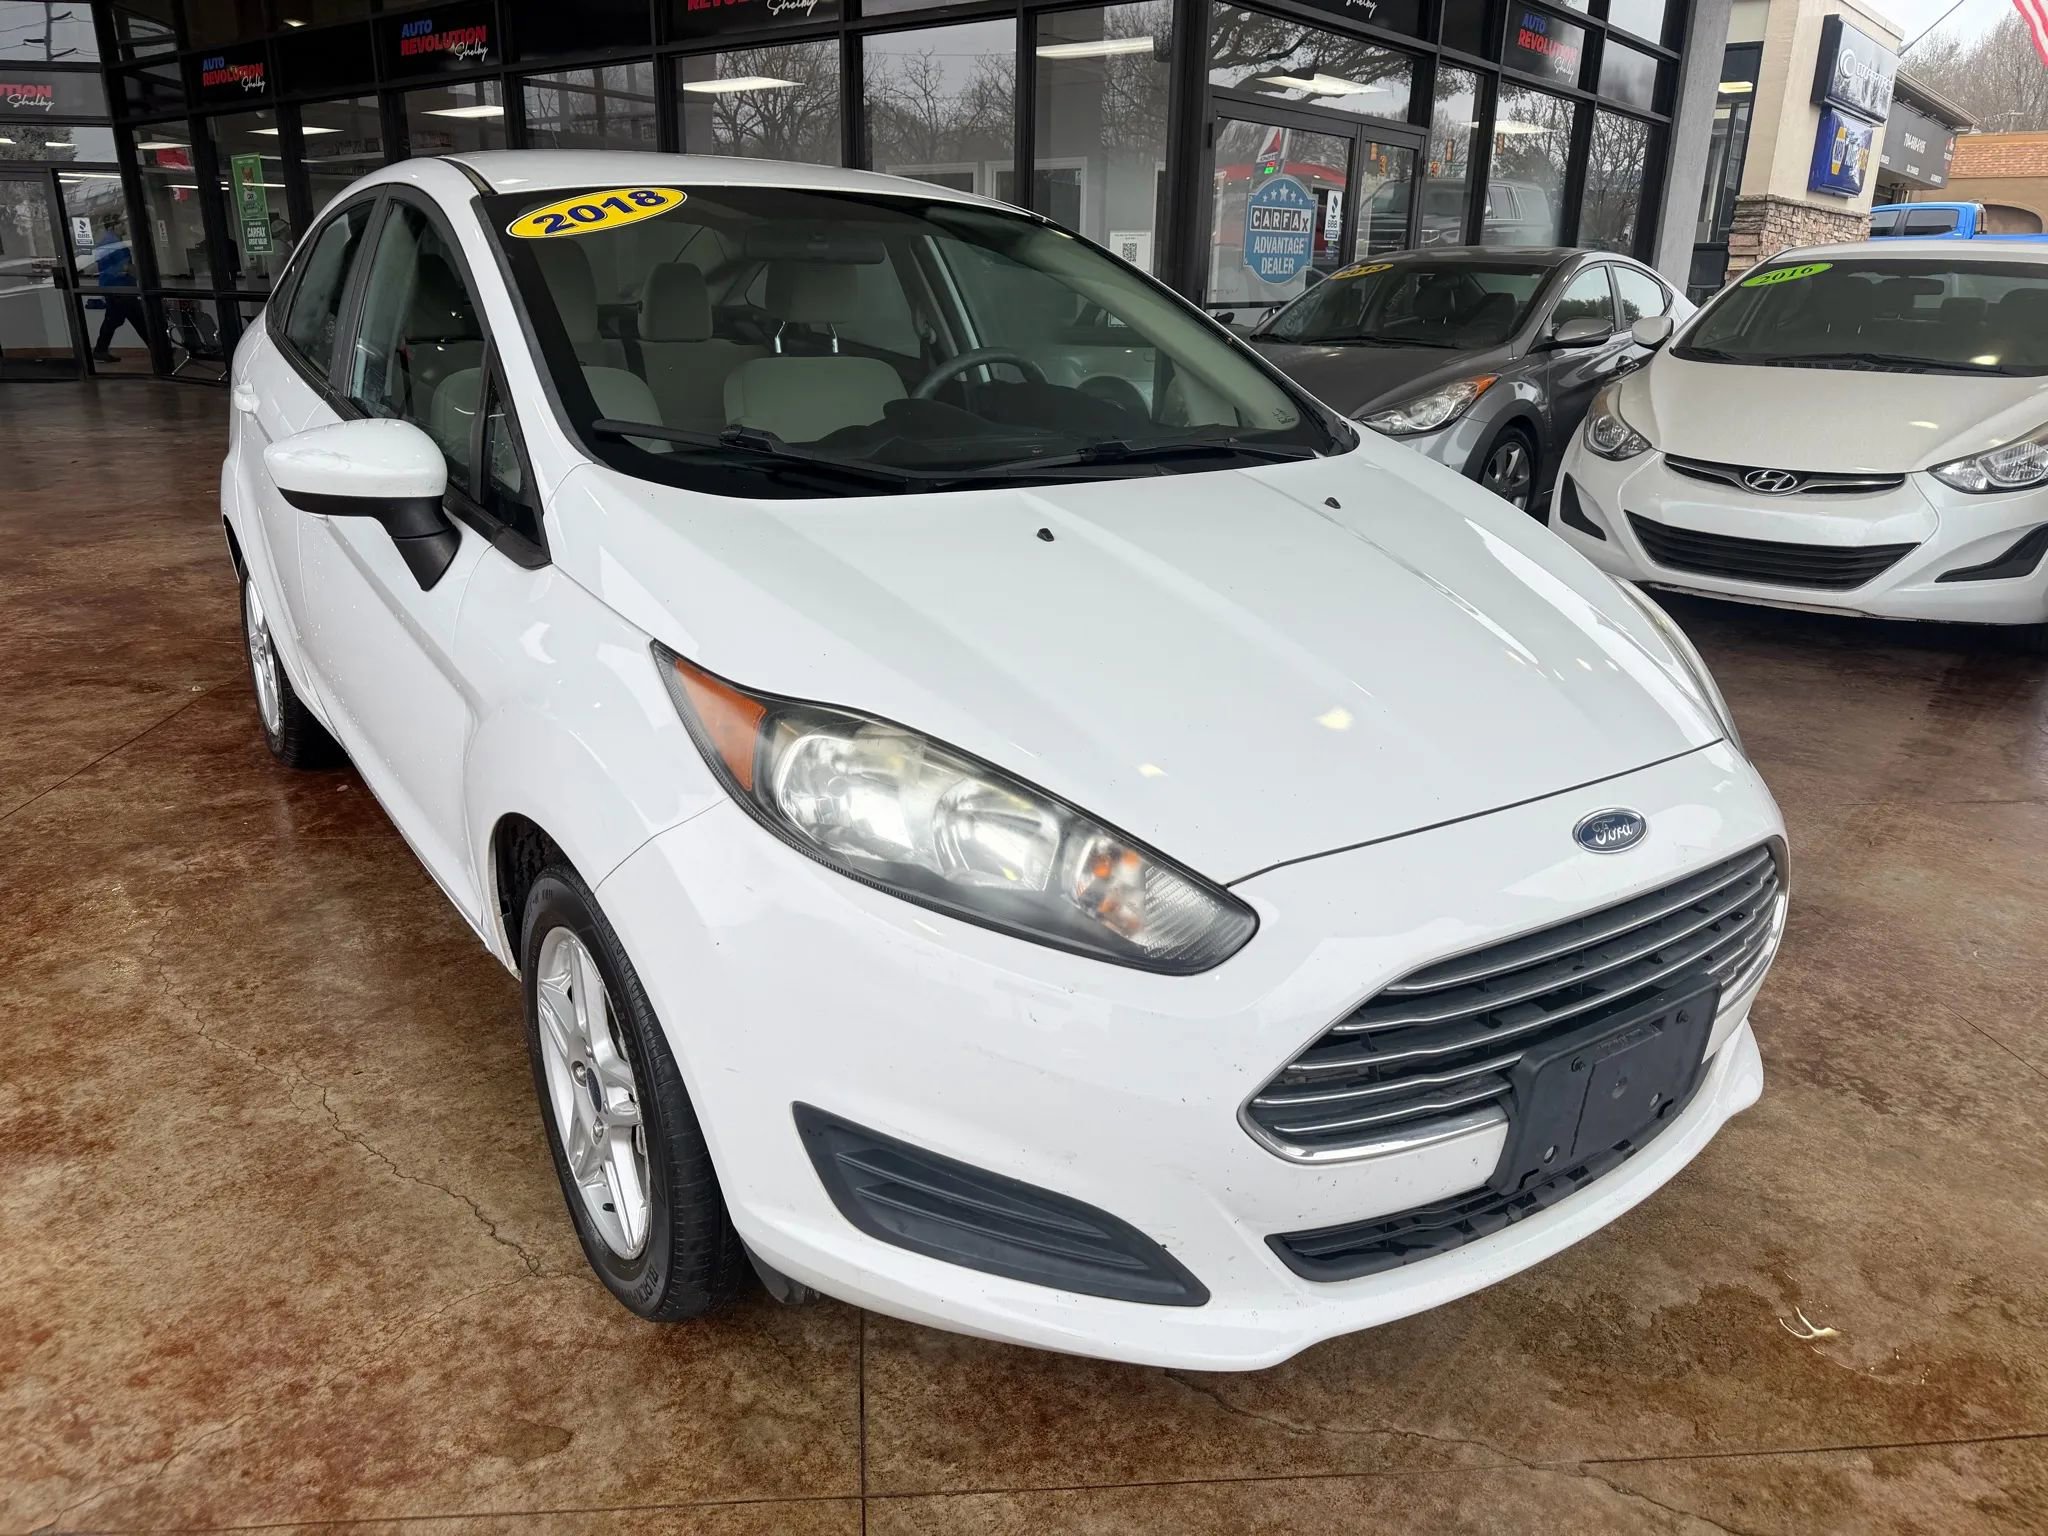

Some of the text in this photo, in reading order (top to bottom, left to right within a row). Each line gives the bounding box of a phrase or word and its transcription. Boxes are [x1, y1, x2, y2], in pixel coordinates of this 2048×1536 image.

[402, 19, 433, 38] AUTO
[1521, 13, 1547, 33] AUTO
[401, 25, 487, 56] REVOLUTION
[454, 38, 489, 62] Shelby
[1518, 28, 1578, 64] REVOLUTION
[202, 56, 225, 71] AUTO
[202, 62, 264, 87] REVOLUTION
[241, 73, 266, 93] Shelby
[7, 93, 55, 112] Shelby
[532, 190, 670, 234] 2018
[1251, 209, 1309, 233] CARFAX
[1252, 236, 1305, 254] ADVANTAGE
[1260, 257, 1295, 275] DEALER
[1756, 266, 1814, 285] 2016
[1591, 817, 1634, 845] Ford
